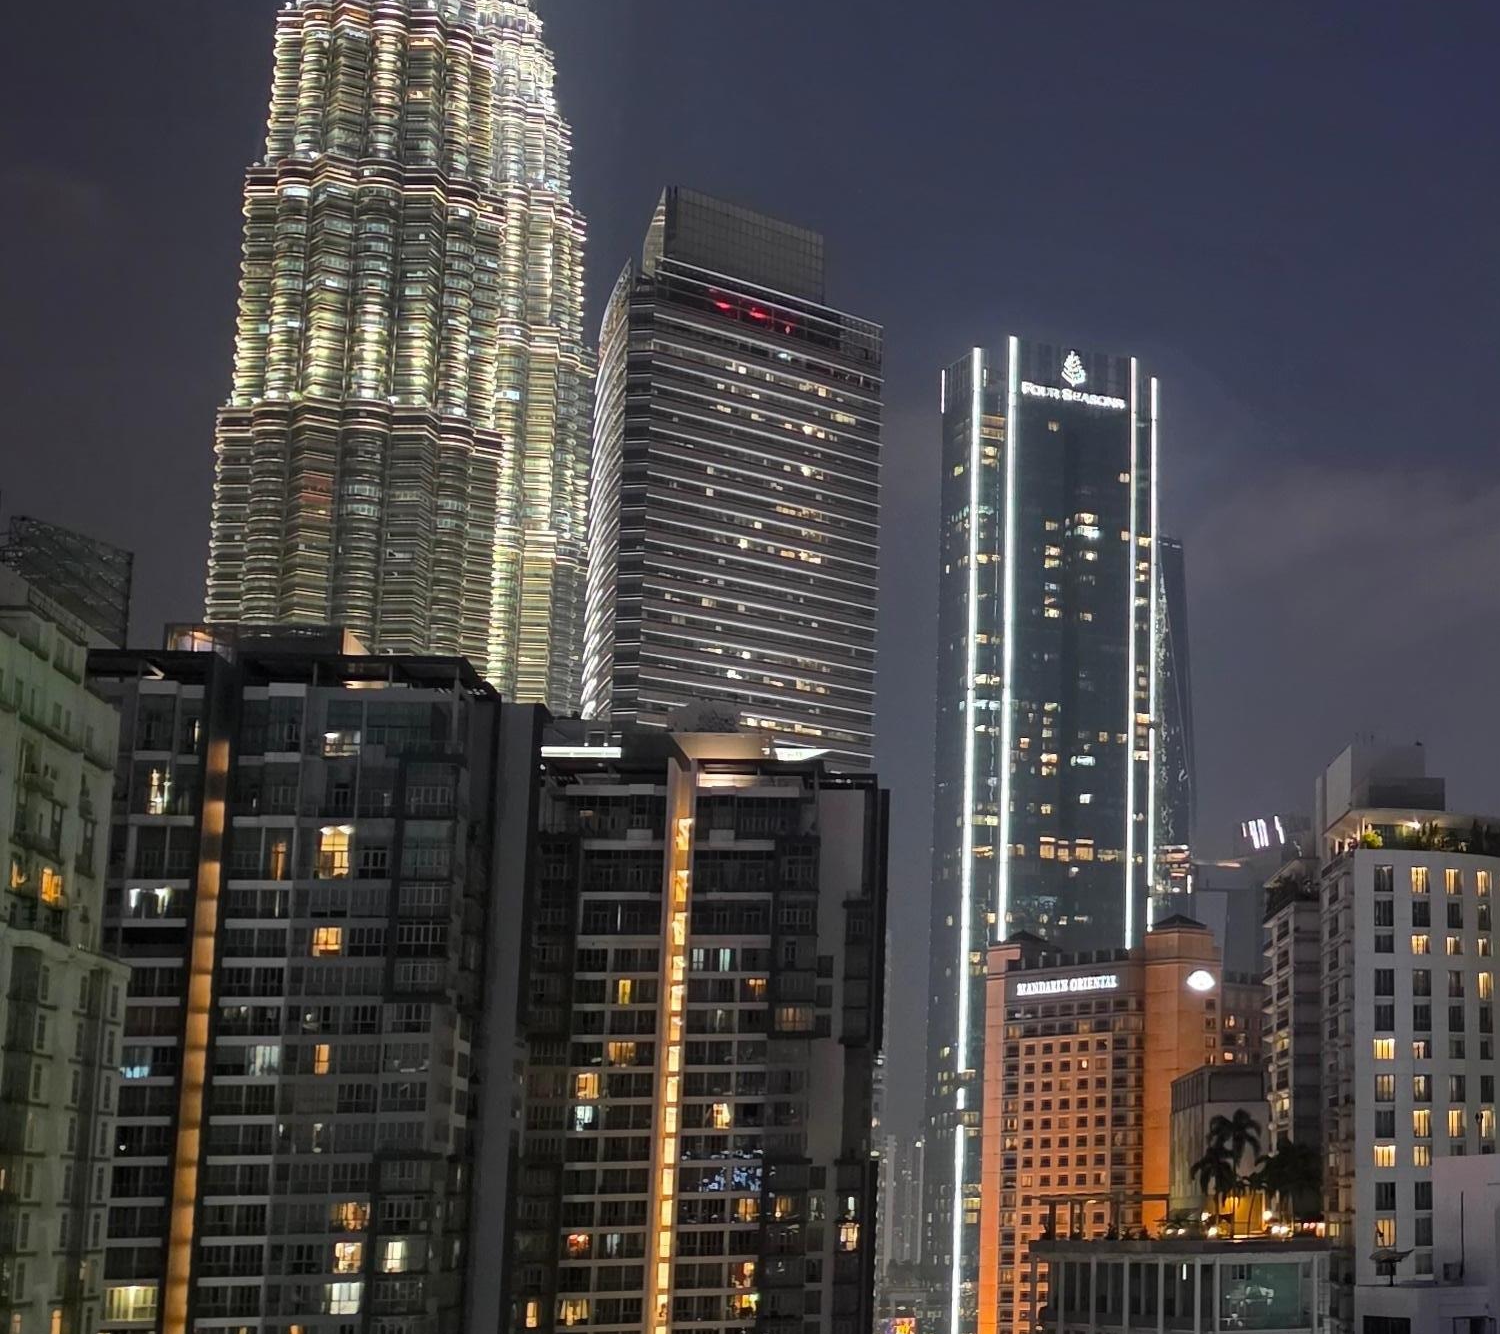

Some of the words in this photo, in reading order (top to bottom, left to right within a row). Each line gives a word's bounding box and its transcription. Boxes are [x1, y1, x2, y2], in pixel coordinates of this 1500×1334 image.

[1021, 381, 1060, 400] FOUR
[1061, 388, 1126, 409] SEASONS
[1069, 975, 1118, 992] ORIENTAL
